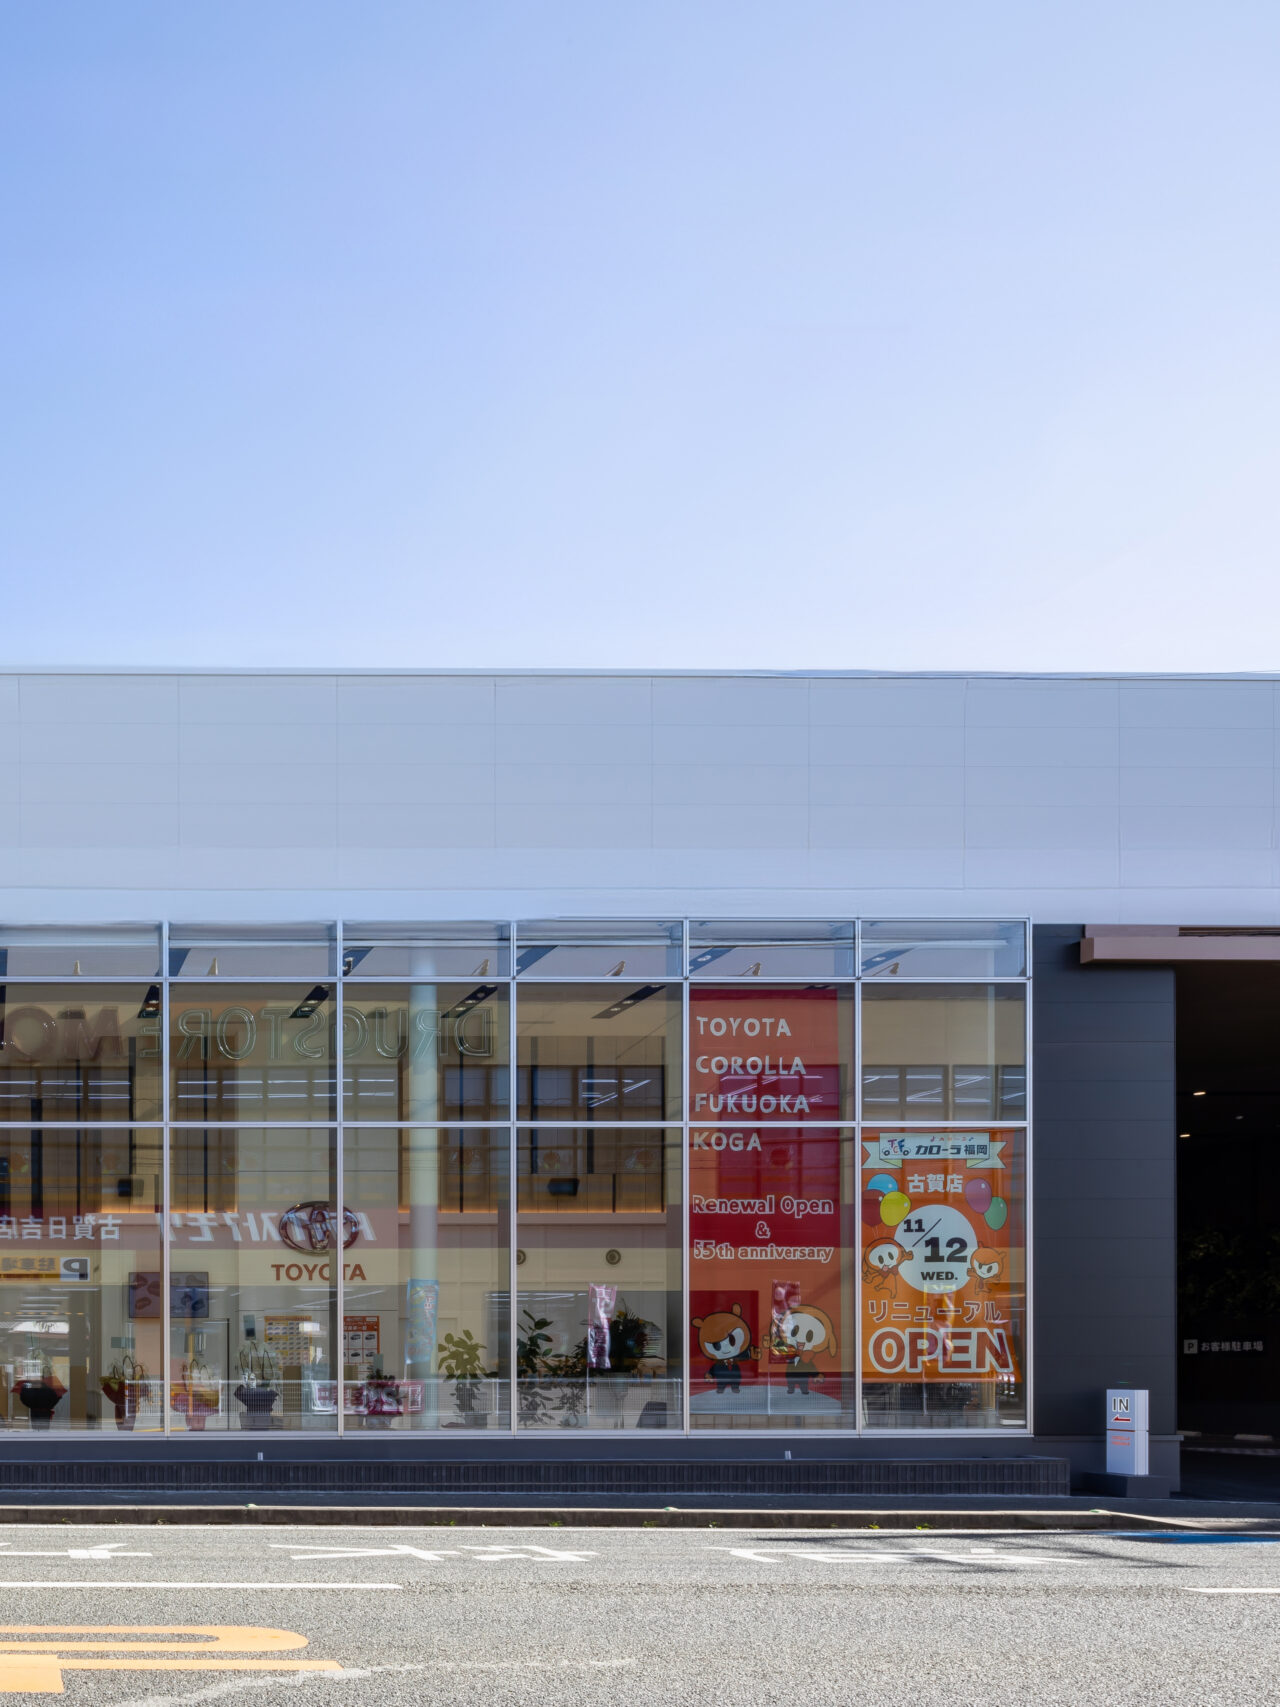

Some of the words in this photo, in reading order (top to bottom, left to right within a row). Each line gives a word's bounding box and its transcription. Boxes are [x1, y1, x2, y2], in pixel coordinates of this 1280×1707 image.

[696, 1015, 792, 1037] TOYOTA
[695, 1055, 807, 1075] COROLLA
[694, 1093, 810, 1113] FUKUOKA
[693, 1131, 762, 1152] KOGA
[915, 1144, 988, 1156] カローラ福岡
[906, 1173, 964, 1193] 古賀店
[692, 1194, 775, 1214] Renewal
[780, 1195, 834, 1219] Open
[755, 1220, 771, 1238] &
[738, 1243, 835, 1264] anniversary
[921, 1272, 959, 1281] WED.
[869, 1300, 1002, 1323] リニューアル
[869, 1327, 1014, 1374] OPEN
[1112, 1397, 1130, 1412] IN
